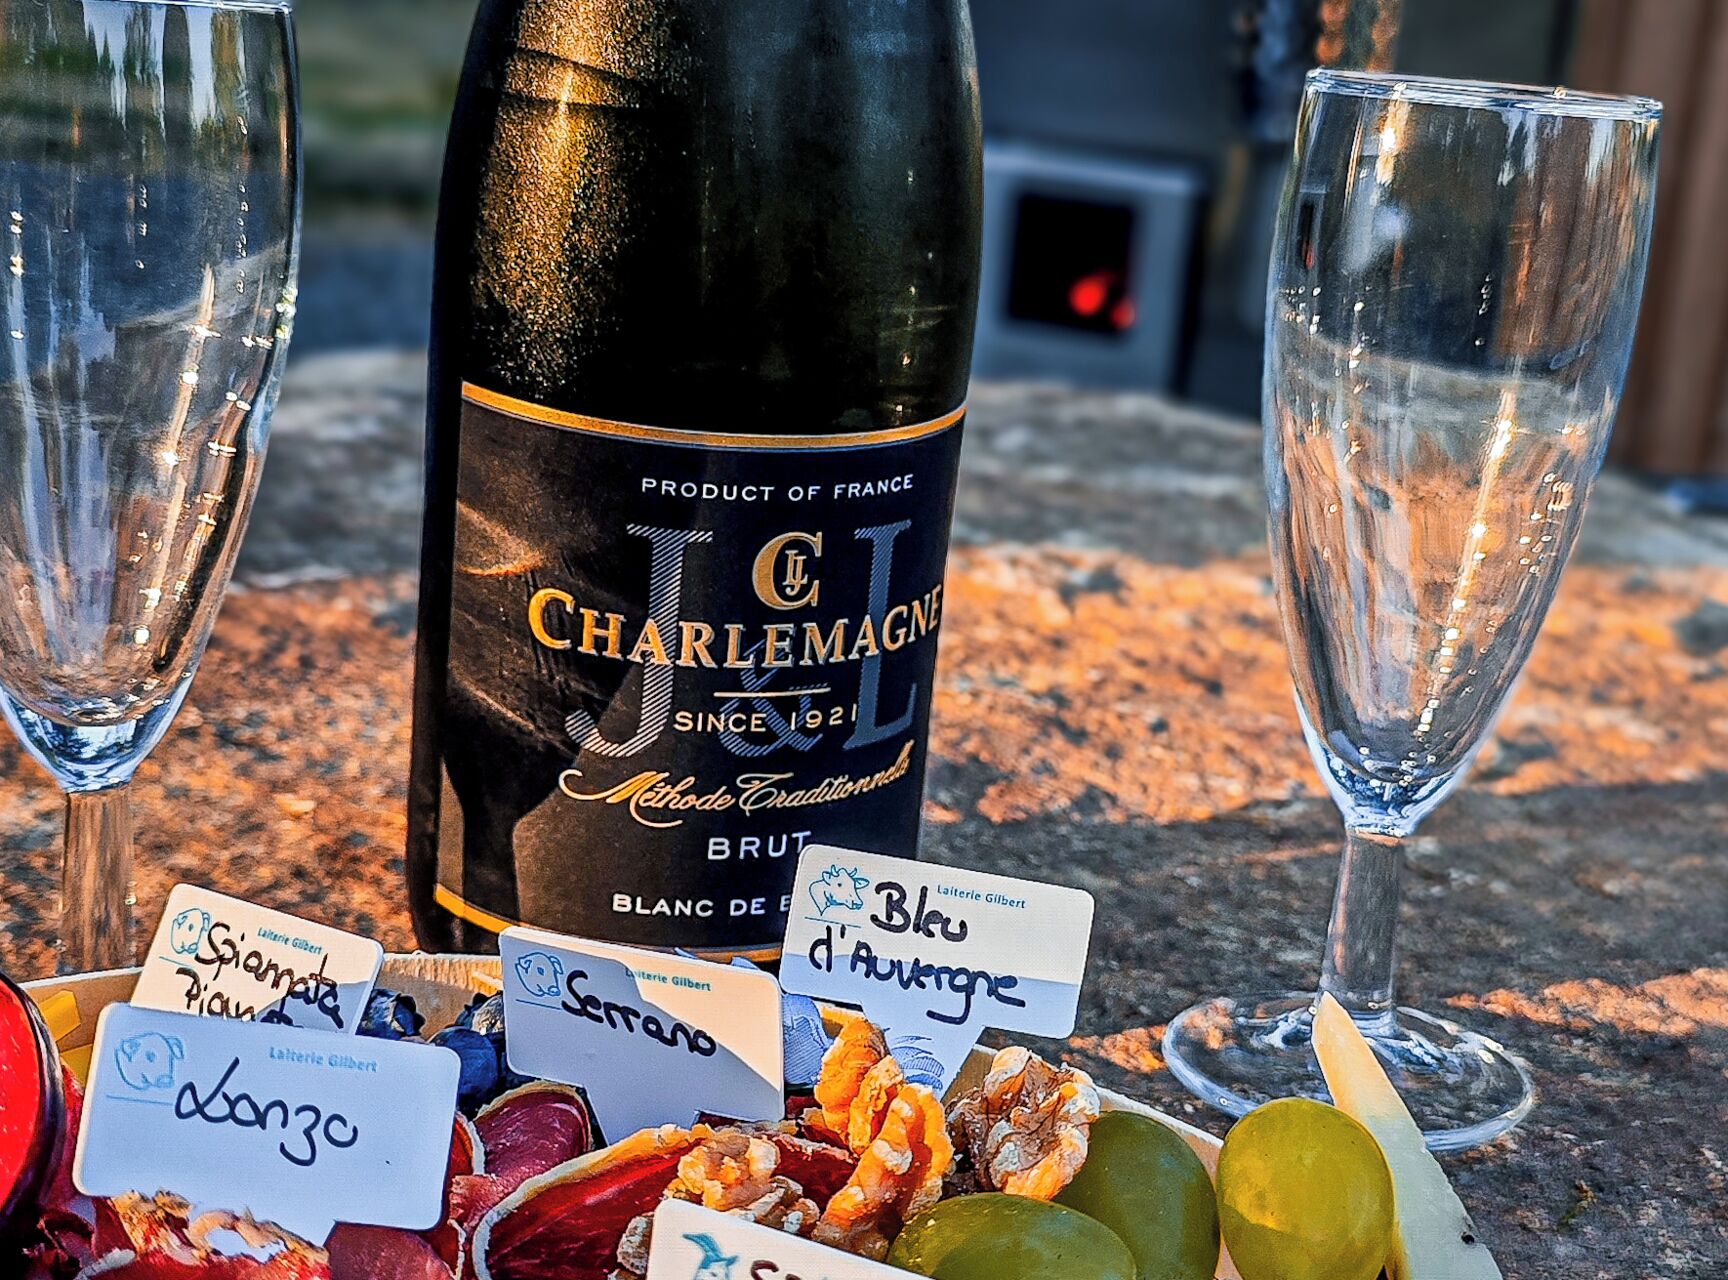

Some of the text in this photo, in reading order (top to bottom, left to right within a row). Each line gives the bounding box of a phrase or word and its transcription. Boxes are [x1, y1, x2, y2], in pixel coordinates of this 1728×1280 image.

[641, 473, 915, 502] PRODUCT OF FRANCE
[528, 583, 942, 669] CHARLEMAGNE
[673, 702, 858, 734] SINCE 1921
[558, 768, 736, 828] Méthode
[708, 830, 812, 861] BRUT
[612, 893, 714, 918] BLANC
[730, 896, 767, 916] DE
[869, 881, 968, 942] Bleu
[937, 883, 1026, 909] Laiterie Gilbert
[257, 927, 322, 956] Laiterie Gilbert
[671, 976, 712, 992] Gilbert
[808, 924, 1026, 1025] d'Auvergne
[561, 970, 717, 1057] Serrano
[268, 1046, 378, 1073] Laiterie Gilbert
[174, 1056, 359, 1167] Lonzo
